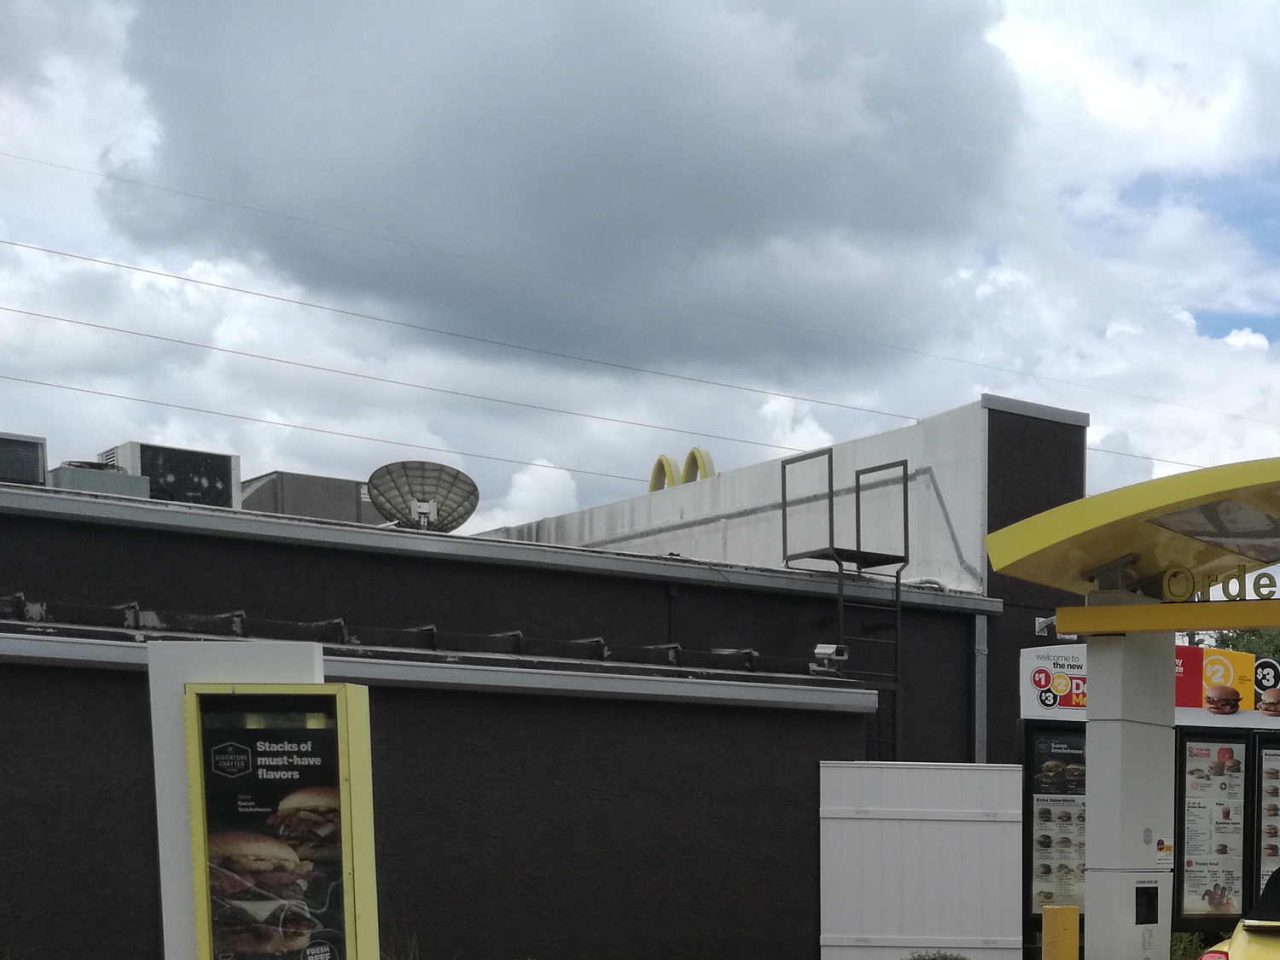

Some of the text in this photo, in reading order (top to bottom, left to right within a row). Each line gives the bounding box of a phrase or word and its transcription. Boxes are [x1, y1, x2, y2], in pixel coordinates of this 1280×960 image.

[1036, 653, 1070, 662] welcome
[1053, 661, 1065, 669] the
[1256, 667, 1275, 687] $3
[1041, 692, 1054, 705] $3
[256, 741, 312, 752] Stacks of
[257, 755, 322, 766] must-have
[258, 768, 300, 779] flavors
[306, 944, 330, 956] FRESH
